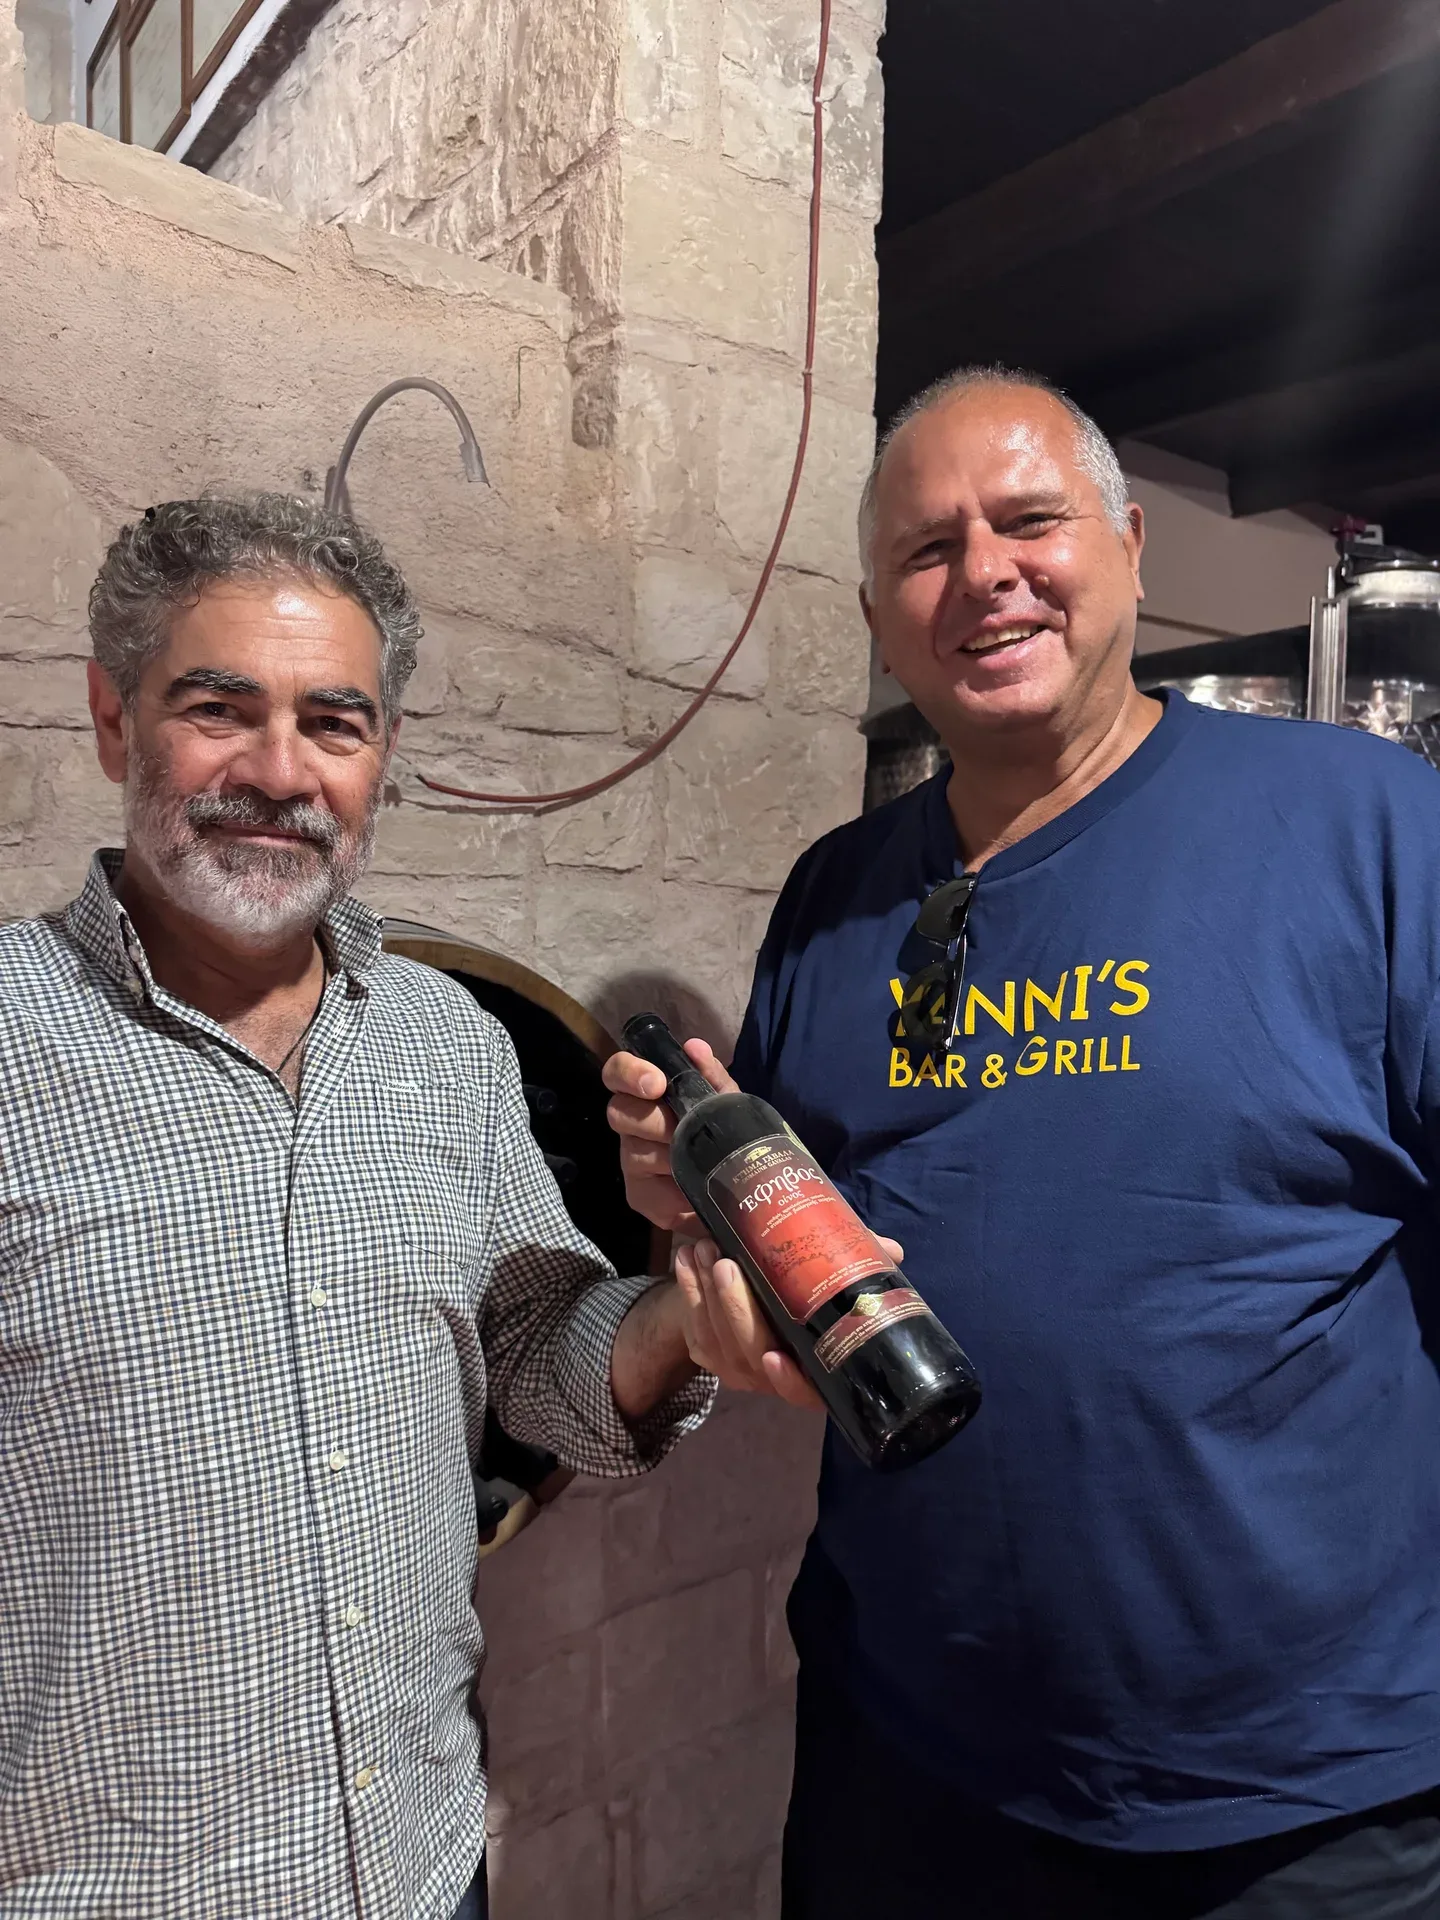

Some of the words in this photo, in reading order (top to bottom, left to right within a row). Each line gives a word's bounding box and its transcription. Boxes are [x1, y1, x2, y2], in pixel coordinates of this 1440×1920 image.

[889, 1047, 968, 1088] BAR
[981, 1054, 1008, 1088] &
[1015, 1035, 1140, 1076] GRILL
